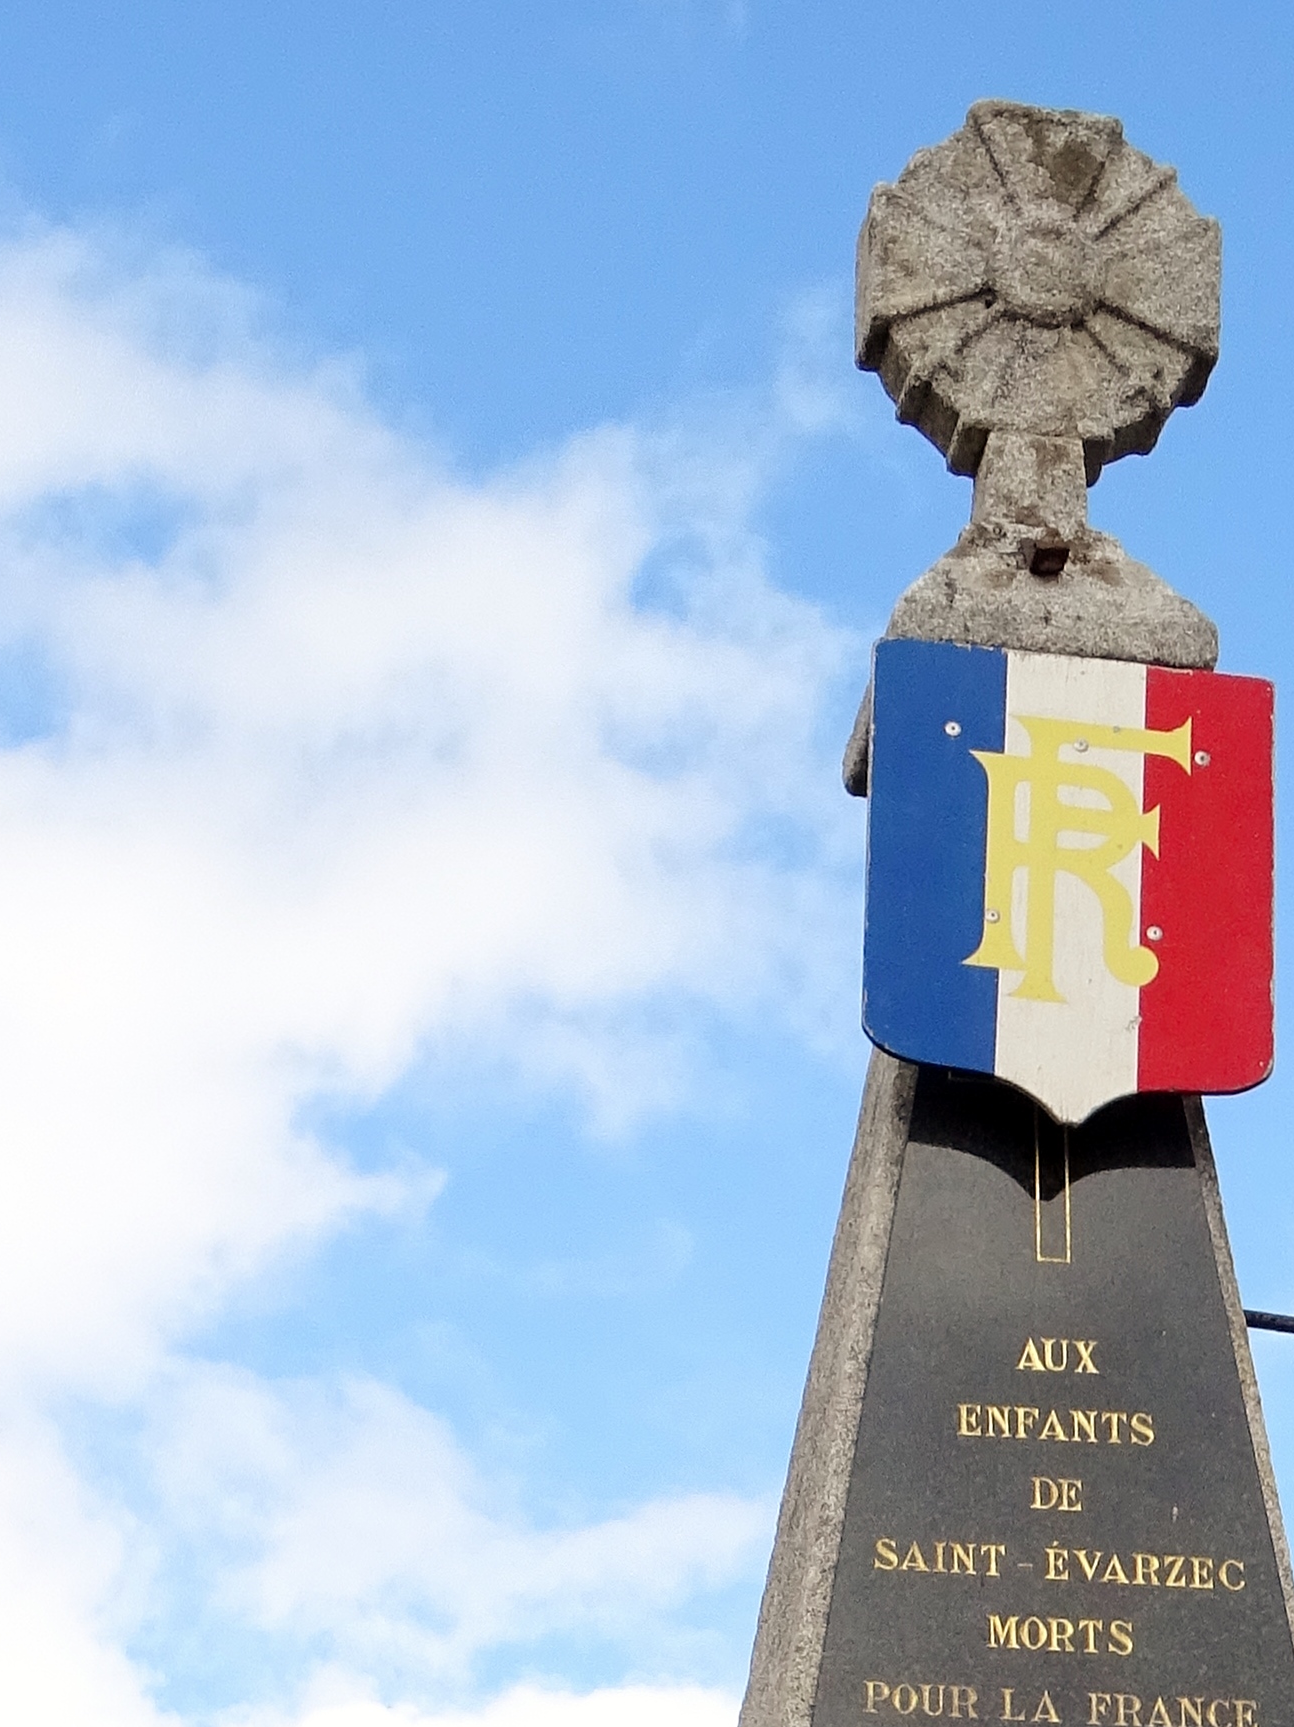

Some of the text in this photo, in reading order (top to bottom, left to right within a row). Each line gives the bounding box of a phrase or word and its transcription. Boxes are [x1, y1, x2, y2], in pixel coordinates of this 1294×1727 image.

[1016, 1338, 1099, 1374] AUX
[957, 1404, 1155, 1446] ENFANTS
[1030, 1477, 1082, 1511] DE
[987, 1615, 1133, 1656] MORTS
[865, 1681, 978, 1718] POUR
[1001, 1689, 1062, 1723] LA
